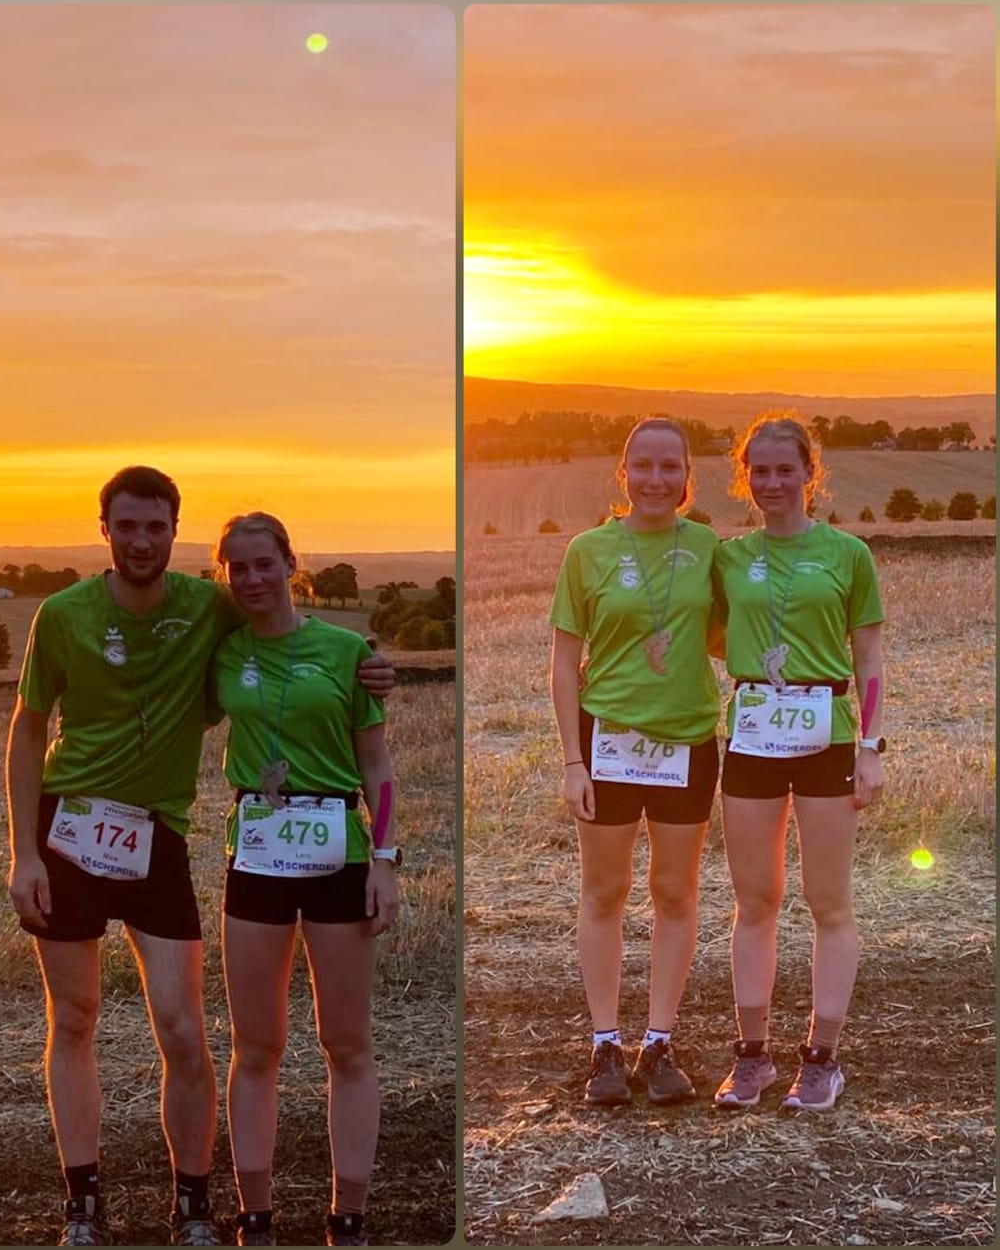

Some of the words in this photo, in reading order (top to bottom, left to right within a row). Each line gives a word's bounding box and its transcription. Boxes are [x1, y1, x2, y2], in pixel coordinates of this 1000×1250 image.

[769, 707, 816, 730] 479
[631, 738, 675, 758] 476
[635, 770, 681, 781] SCHERDEL
[94, 822, 138, 853] 174
[277, 819, 329, 846] 479
[92, 860, 139, 877] SCHERDEL
[285, 862, 336, 871] SCHERDEL
